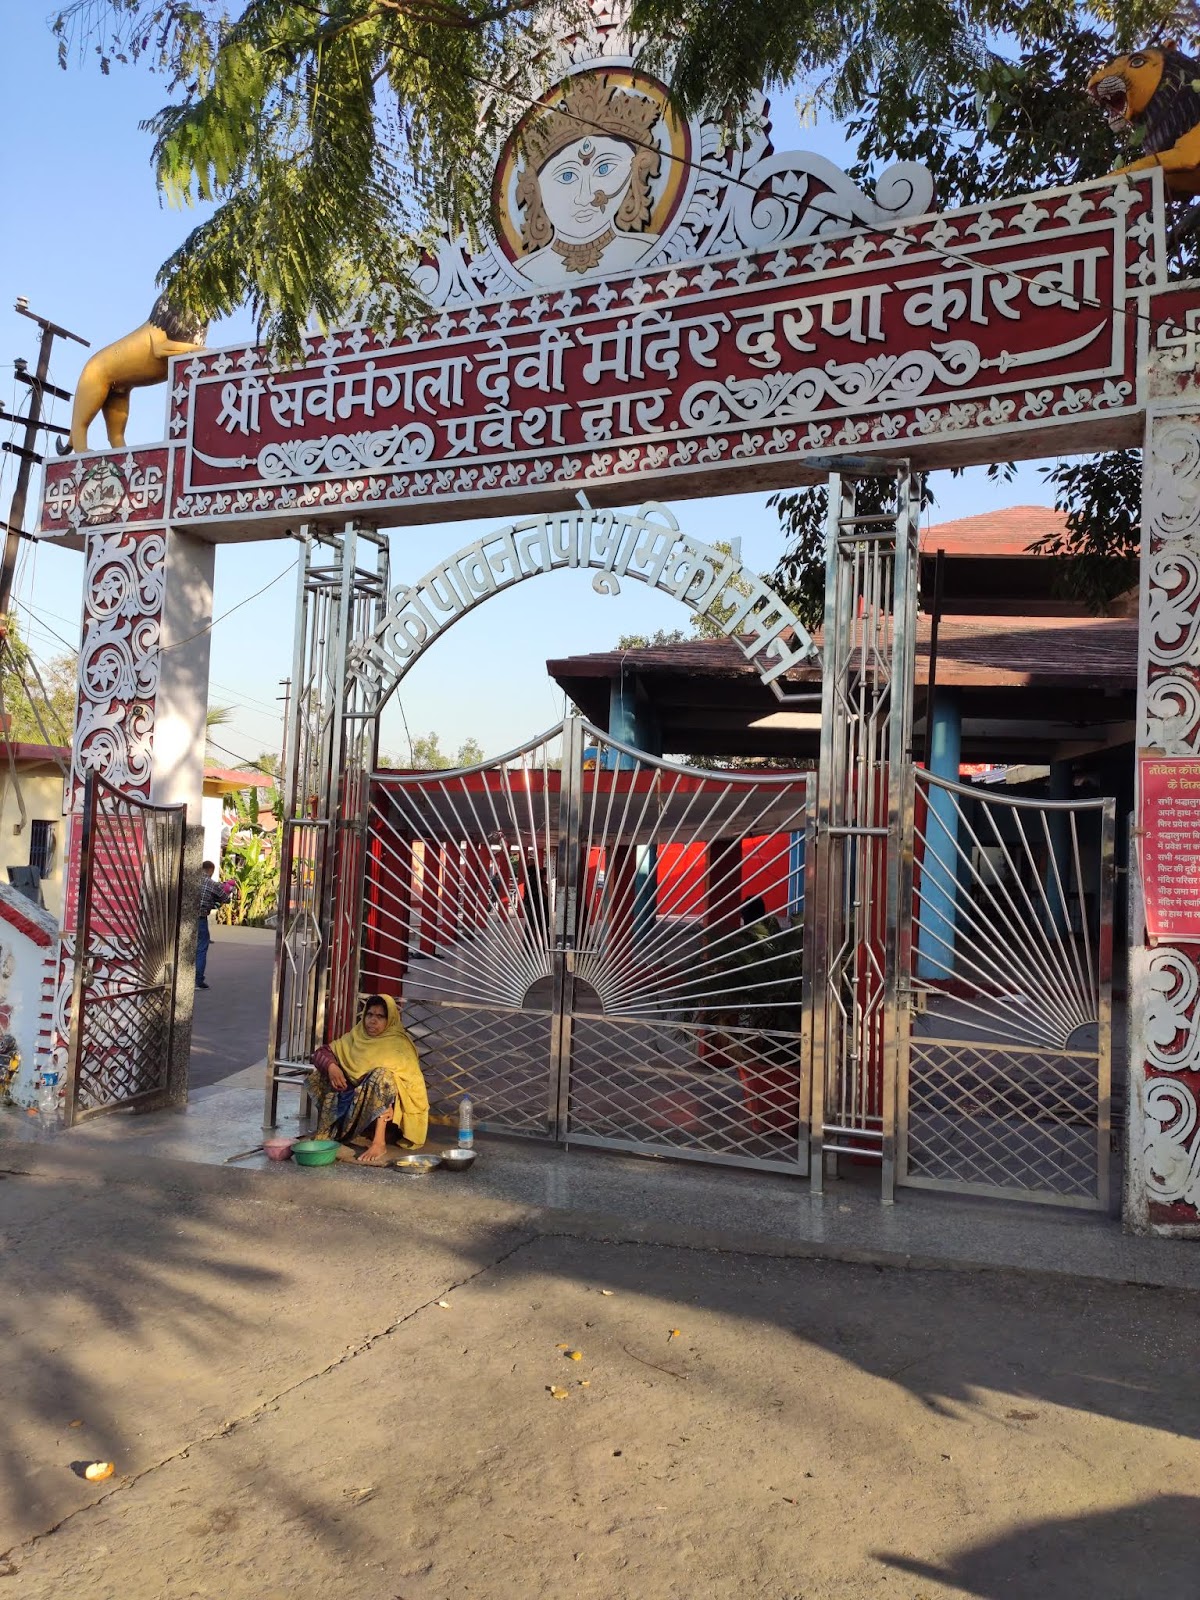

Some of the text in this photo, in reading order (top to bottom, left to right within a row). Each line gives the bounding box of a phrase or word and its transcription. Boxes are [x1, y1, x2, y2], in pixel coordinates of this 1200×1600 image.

[215, 246, 1110, 436] श्री सर्वमंगला देवी मंदिर दुरपा कोरबा
[436, 399, 573, 458] प्रवेश
